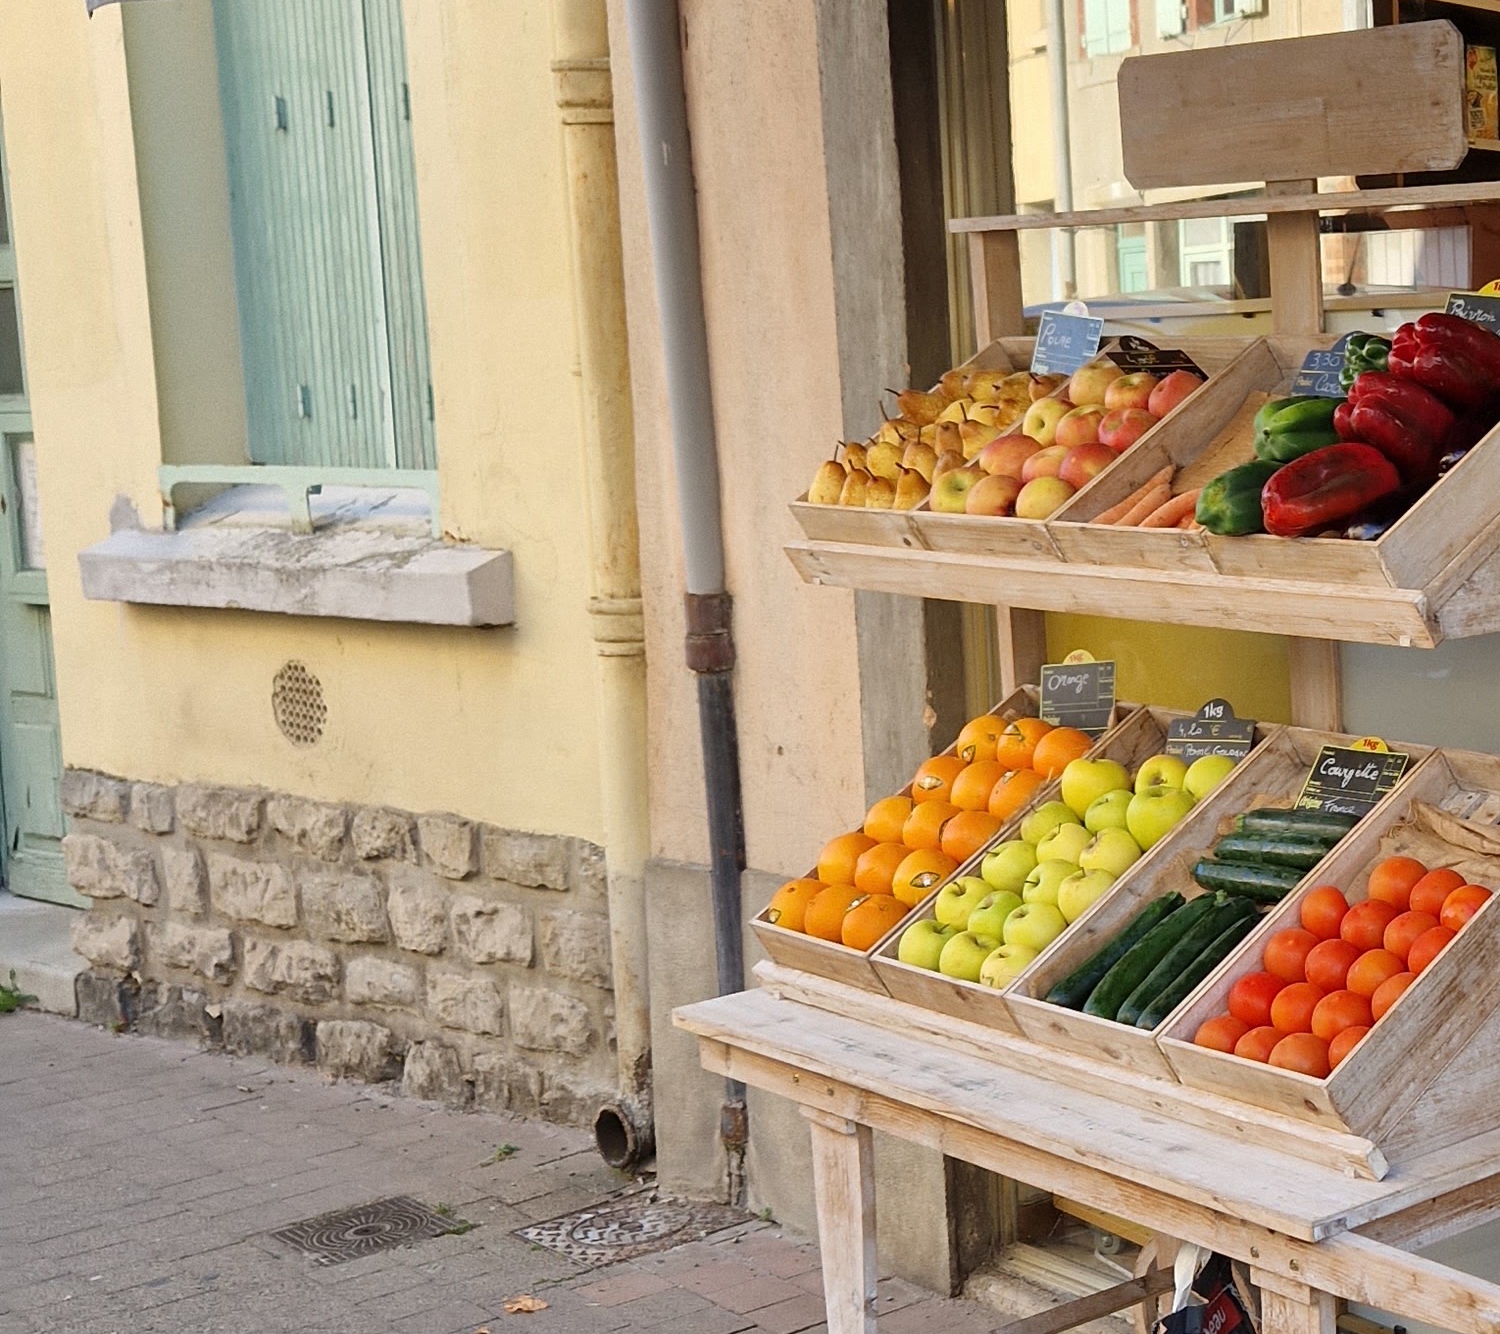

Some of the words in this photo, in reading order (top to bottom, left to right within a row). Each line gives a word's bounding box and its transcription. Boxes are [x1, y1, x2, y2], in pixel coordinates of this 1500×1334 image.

[1048, 673, 1090, 694] Orange
[1203, 702, 1225, 719] 1kg
[1363, 738, 1380, 750] 1kg
